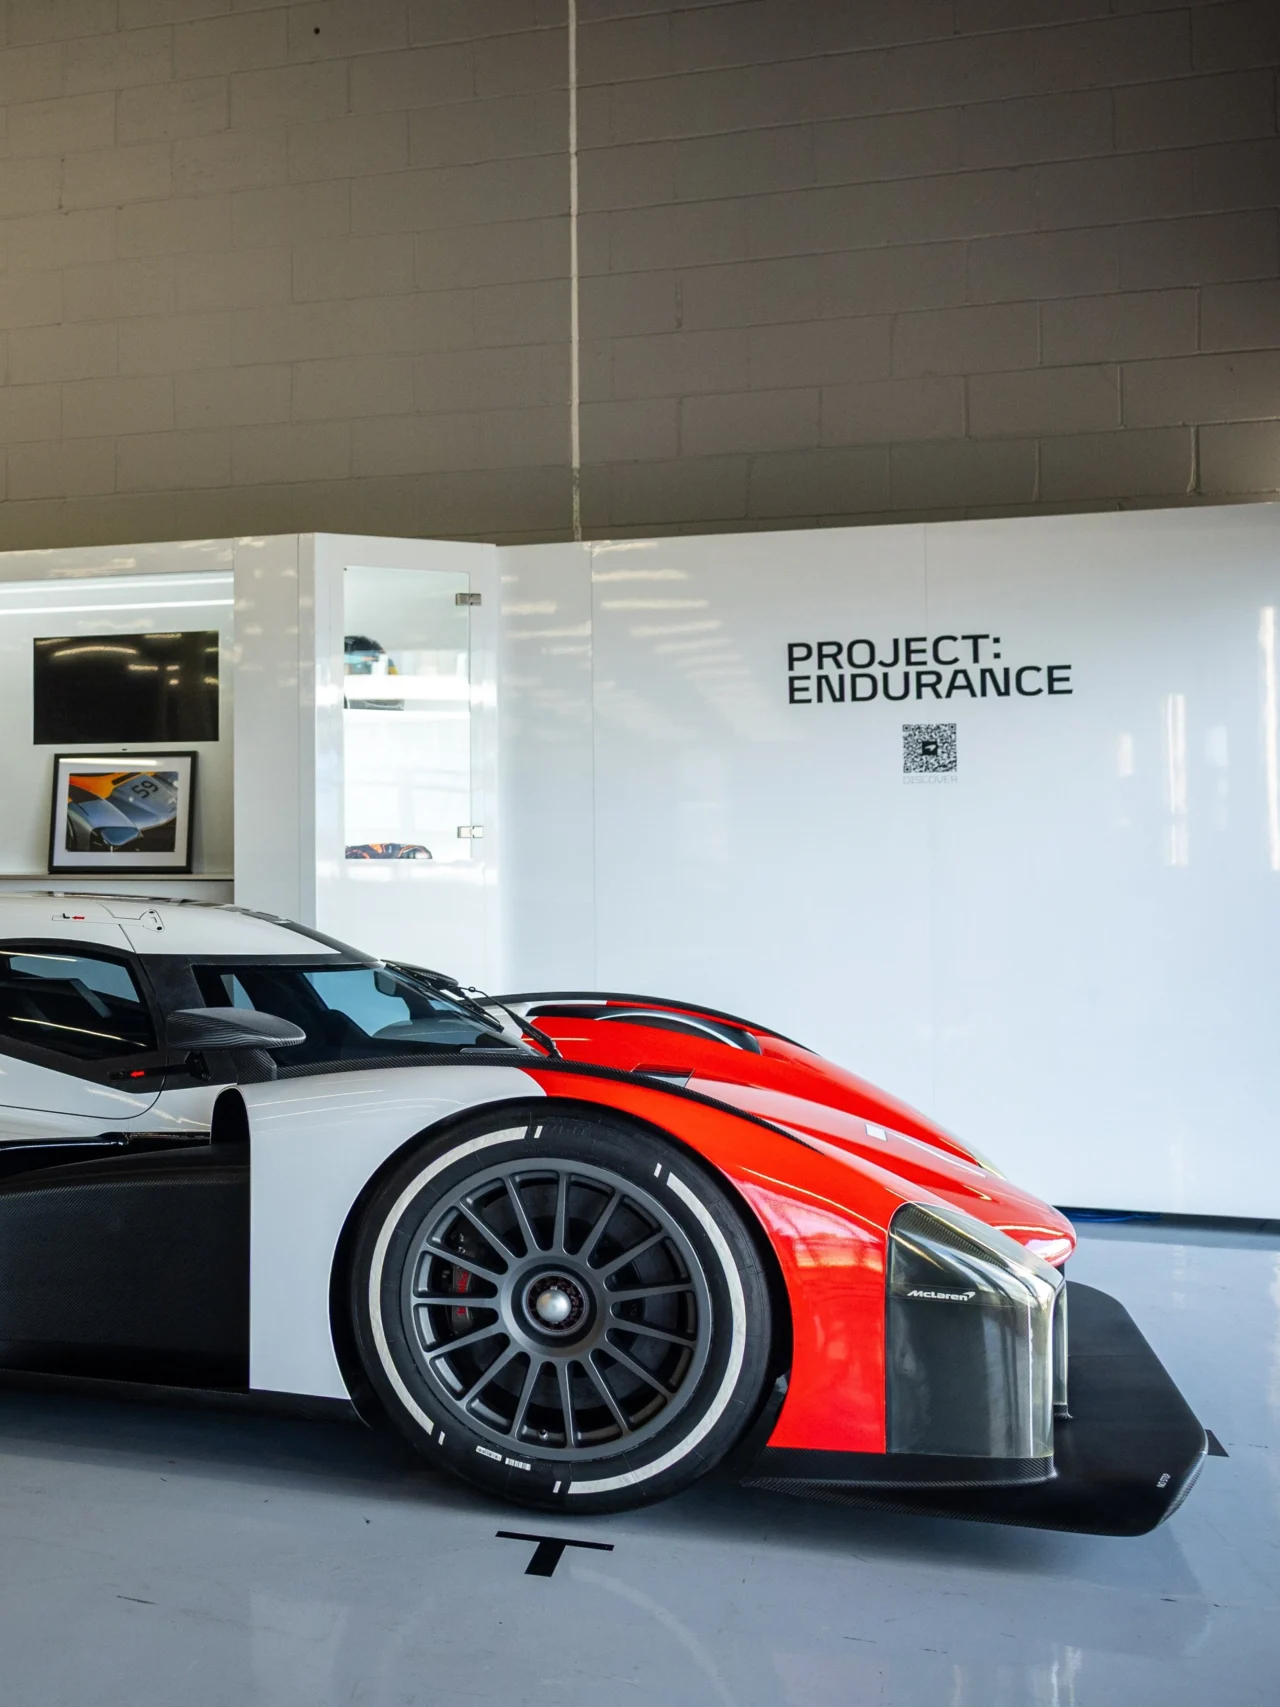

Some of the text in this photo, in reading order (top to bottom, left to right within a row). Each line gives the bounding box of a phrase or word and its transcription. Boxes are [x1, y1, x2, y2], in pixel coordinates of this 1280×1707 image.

[787, 634, 1001, 671] PROJECT:
[788, 664, 1073, 704] ENDURANCE
[902, 775, 958, 785] DISCOVER
[907, 1290, 968, 1301] McLaren
